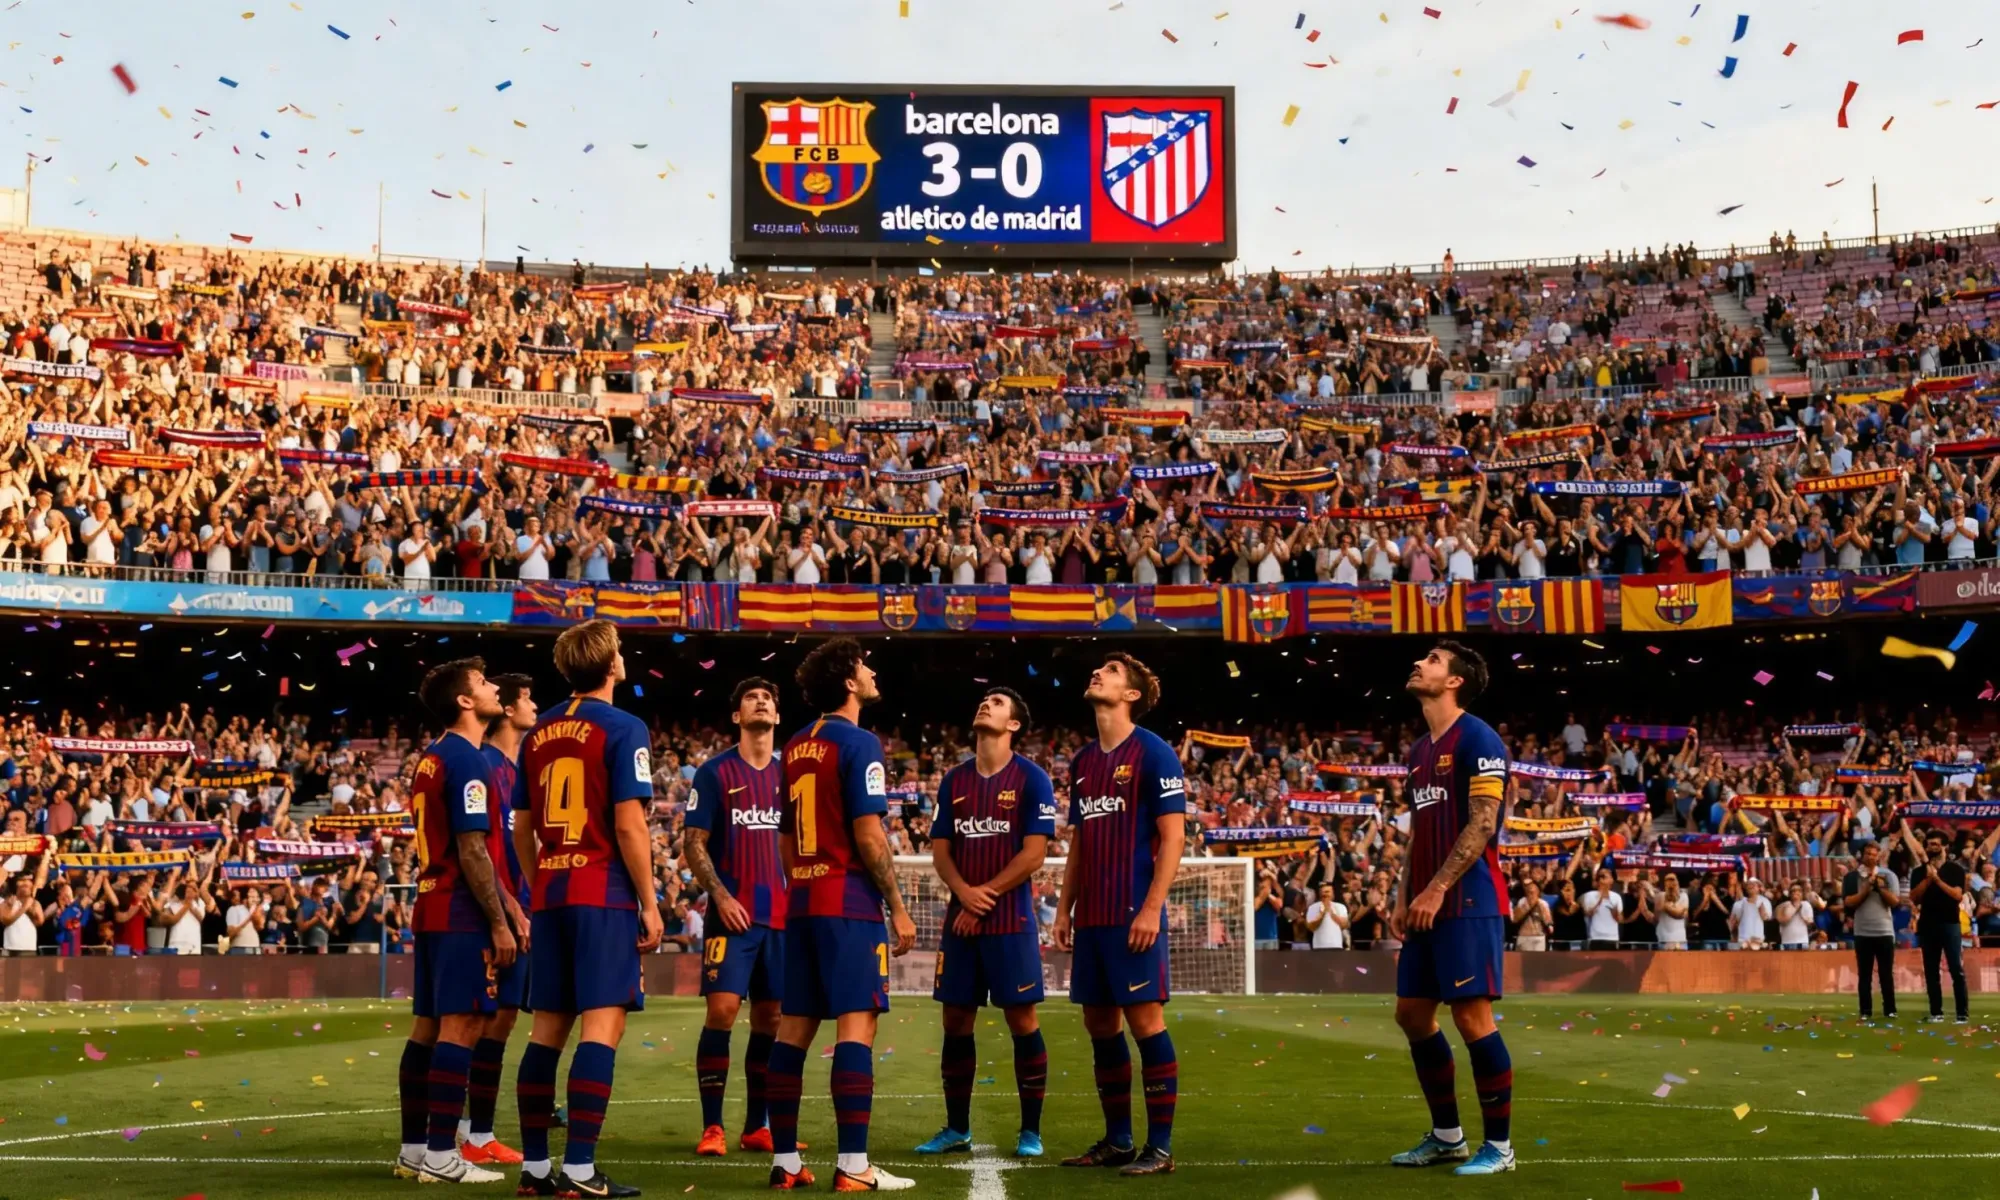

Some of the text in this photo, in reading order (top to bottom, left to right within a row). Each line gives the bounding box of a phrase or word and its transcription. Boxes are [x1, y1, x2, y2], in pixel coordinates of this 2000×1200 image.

[905, 102, 1060, 135] barcelona
[880, 204, 967, 231] atletico
[970, 204, 1000, 230] de
[1002, 204, 1082, 231] madrid
